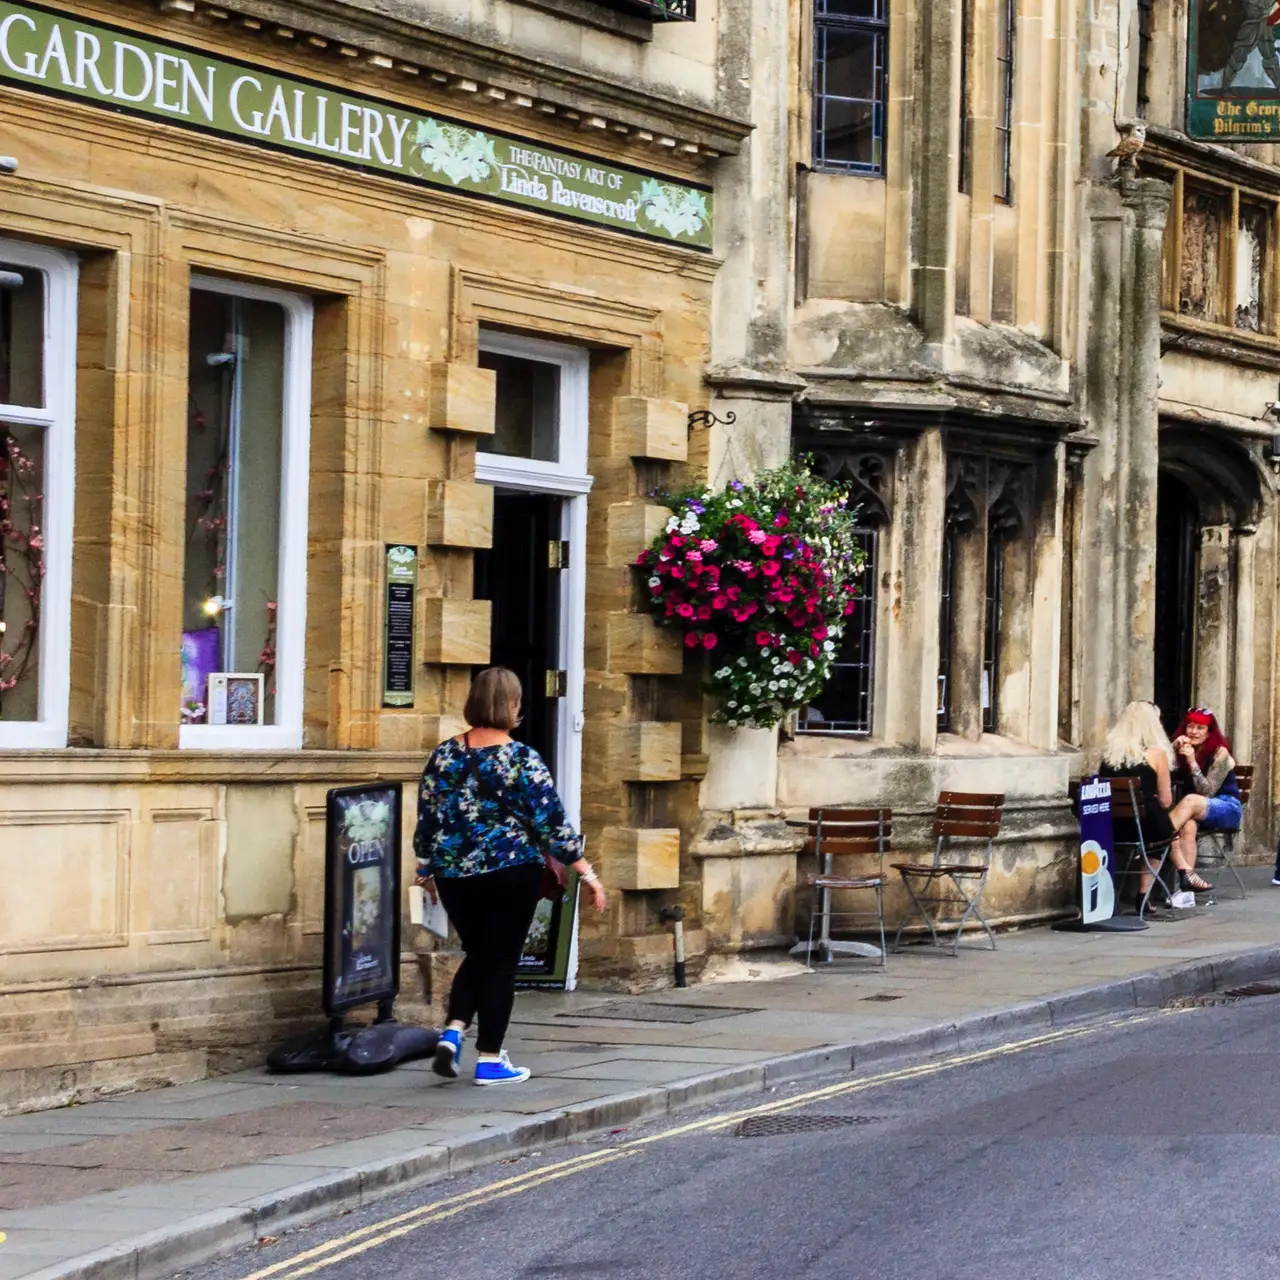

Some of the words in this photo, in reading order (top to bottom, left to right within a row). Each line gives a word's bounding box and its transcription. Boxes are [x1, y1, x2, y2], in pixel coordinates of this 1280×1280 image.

[0, 13, 216, 122] GARDEN
[229, 76, 412, 169] GALLERY
[1216, 101, 1241, 116] The
[1213, 118, 1271, 135] Pilgrim's
[509, 146, 531, 166] THE
[534, 152, 582, 180] FANTASY
[584, 166, 606, 184] ART
[608, 173, 623, 190] OF
[500, 168, 548, 201] Linda
[552, 179, 637, 223] Ravenscroft
[348, 840, 385, 864] OPEN
